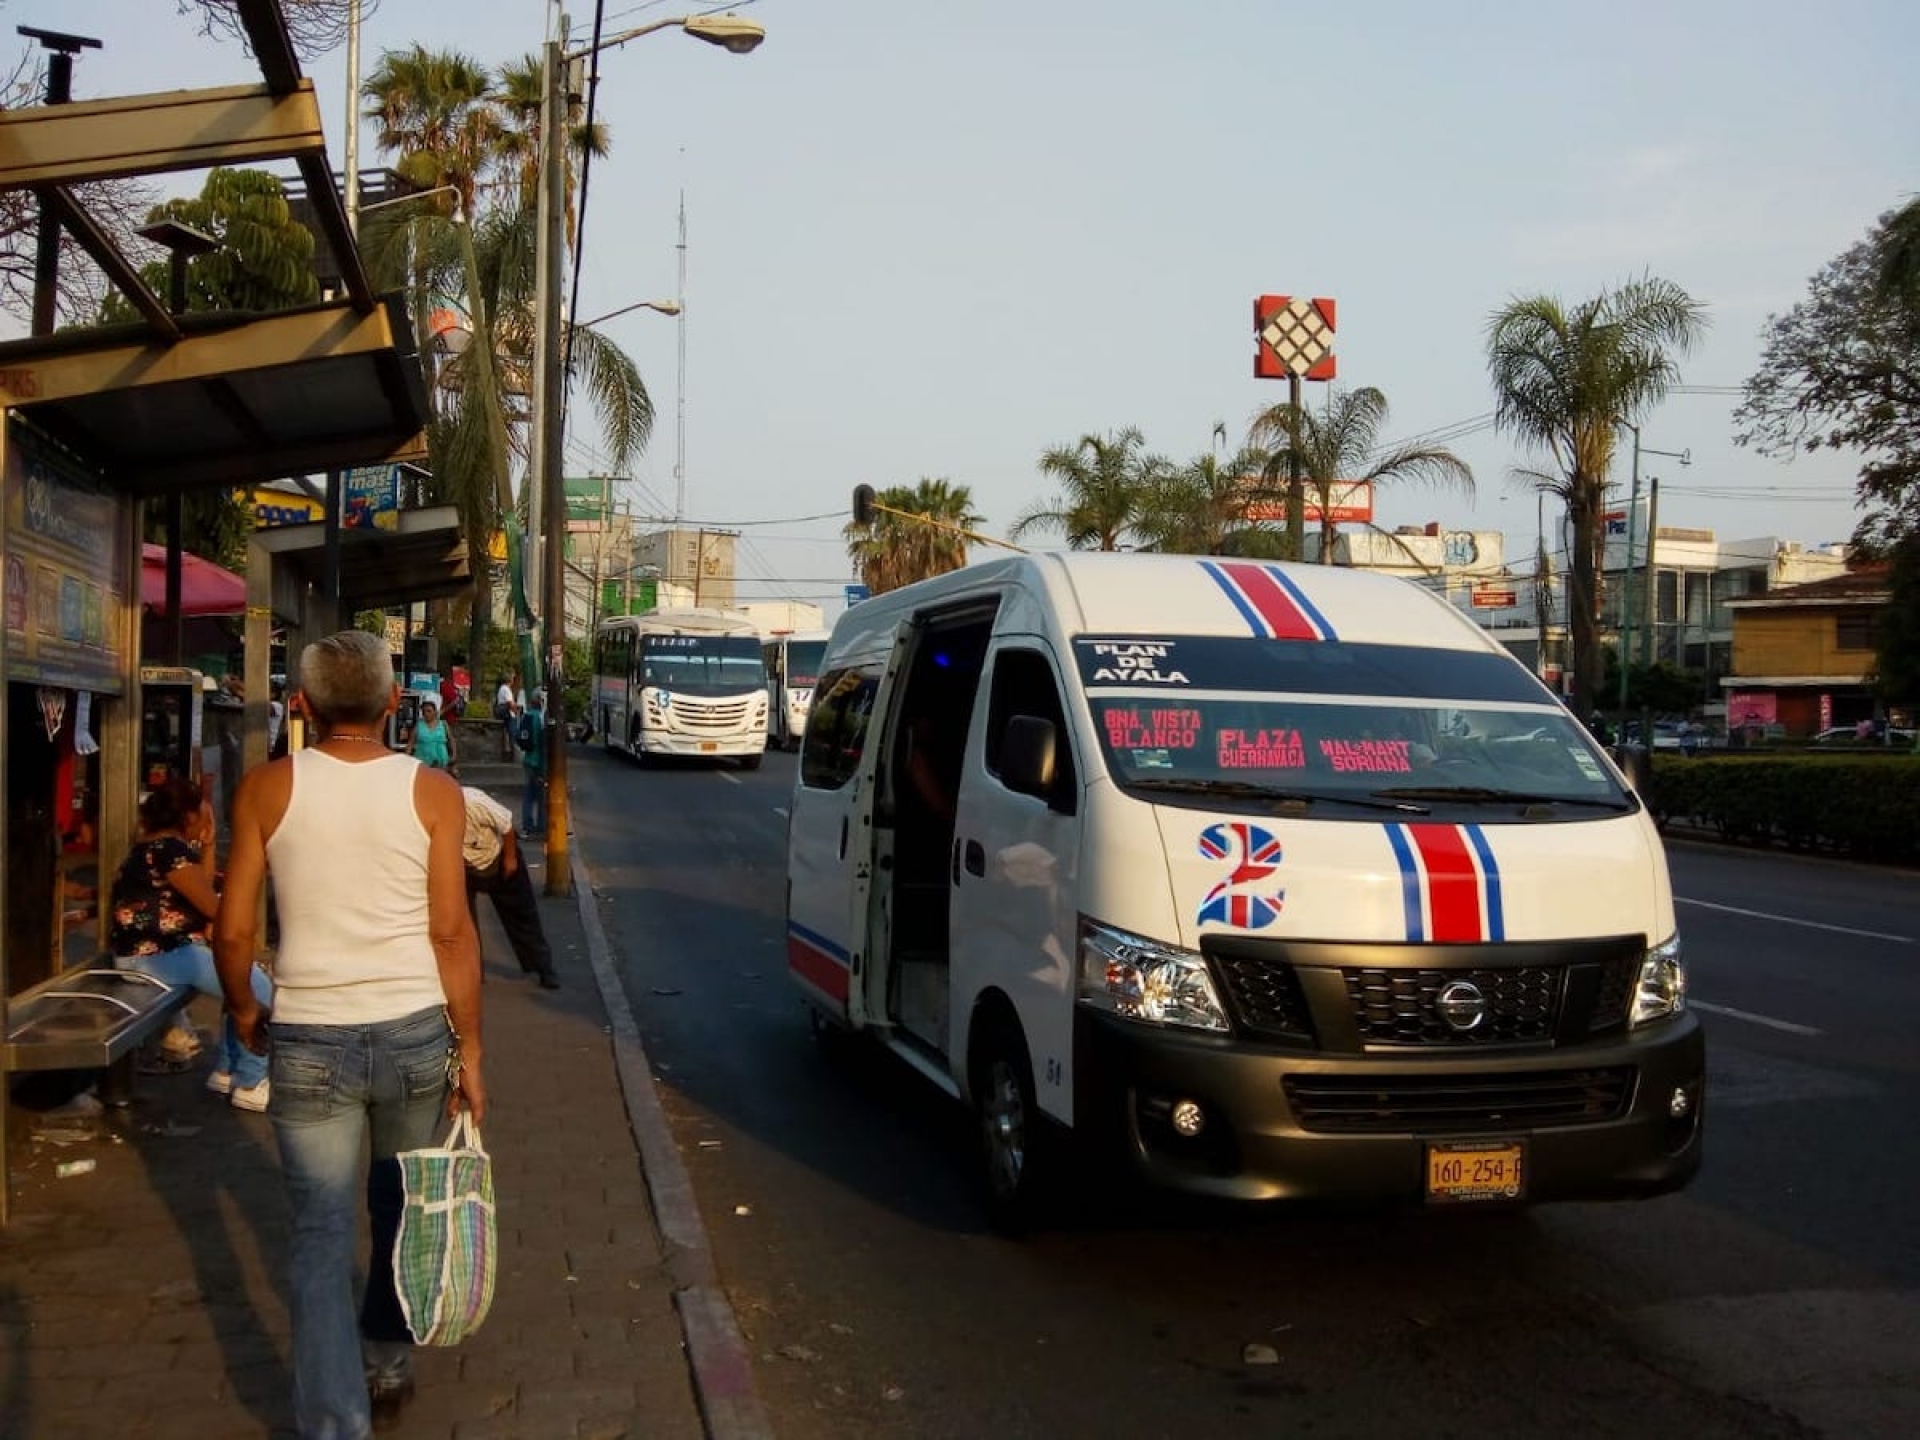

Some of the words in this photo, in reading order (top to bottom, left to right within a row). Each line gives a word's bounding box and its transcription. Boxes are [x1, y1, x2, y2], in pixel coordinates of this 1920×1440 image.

[1094, 644, 1168, 657] PLAN
[1117, 657, 1155, 668] DE
[1093, 668, 1191, 684] AYALA
[1152, 708, 1202, 730] VISTA
[1109, 729, 1196, 749] BLANCO
[1218, 729, 1304, 750] PLAZA
[1218, 749, 1306, 768] CUERNAVACA
[1331, 755, 1413, 772] SORIANA
[1197, 823, 1285, 929] 2
